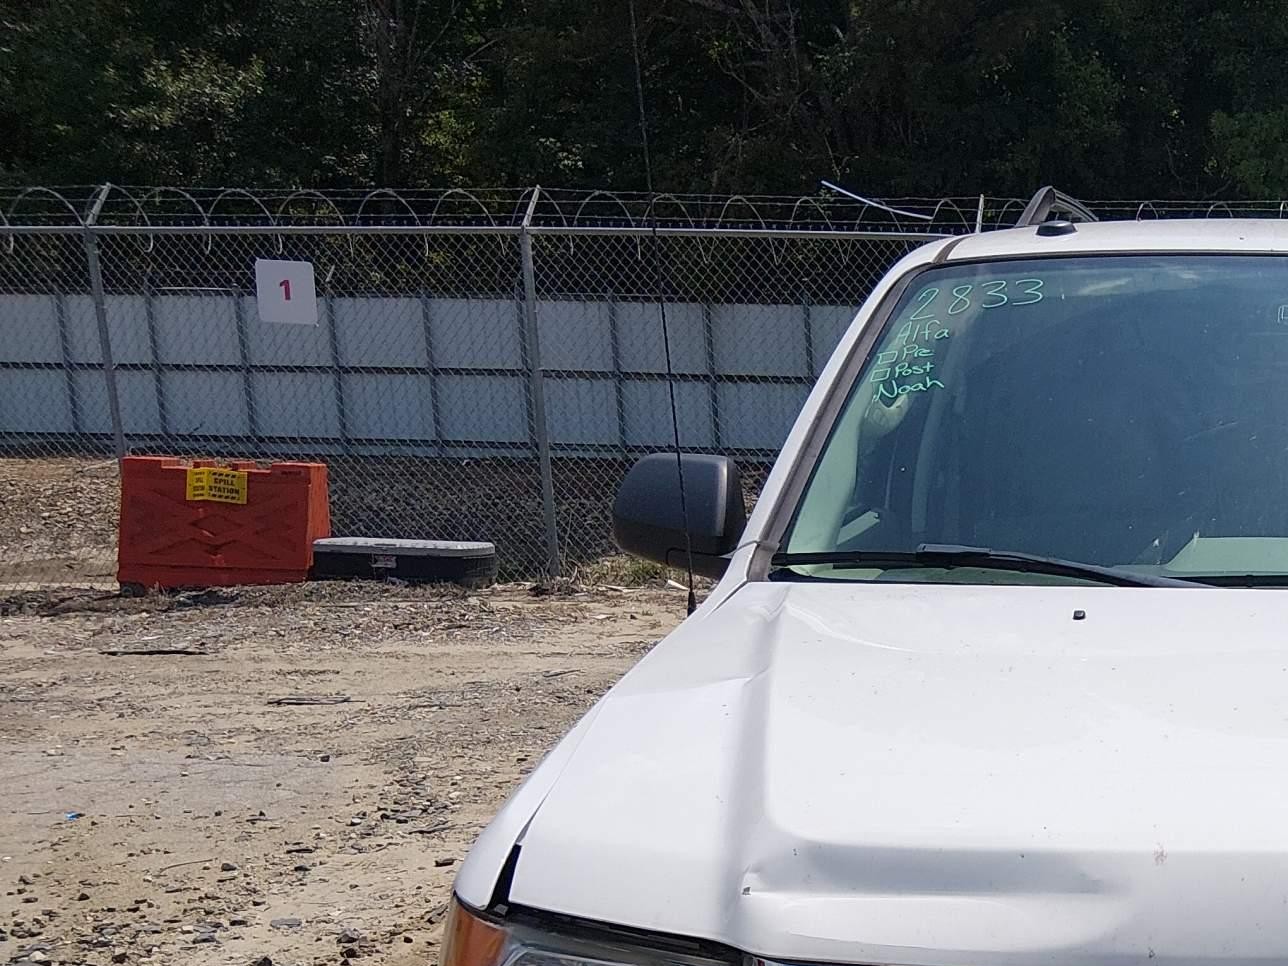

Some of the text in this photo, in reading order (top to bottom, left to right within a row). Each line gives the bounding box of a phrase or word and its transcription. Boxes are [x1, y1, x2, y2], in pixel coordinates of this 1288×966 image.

[279, 279, 291, 301] 1
[910, 279, 1044, 320] 2833
[895, 319, 950, 345] Alfa
[894, 363, 935, 378] Post
[872, 376, 945, 402] Noah
[208, 485, 240, 495] STATION
